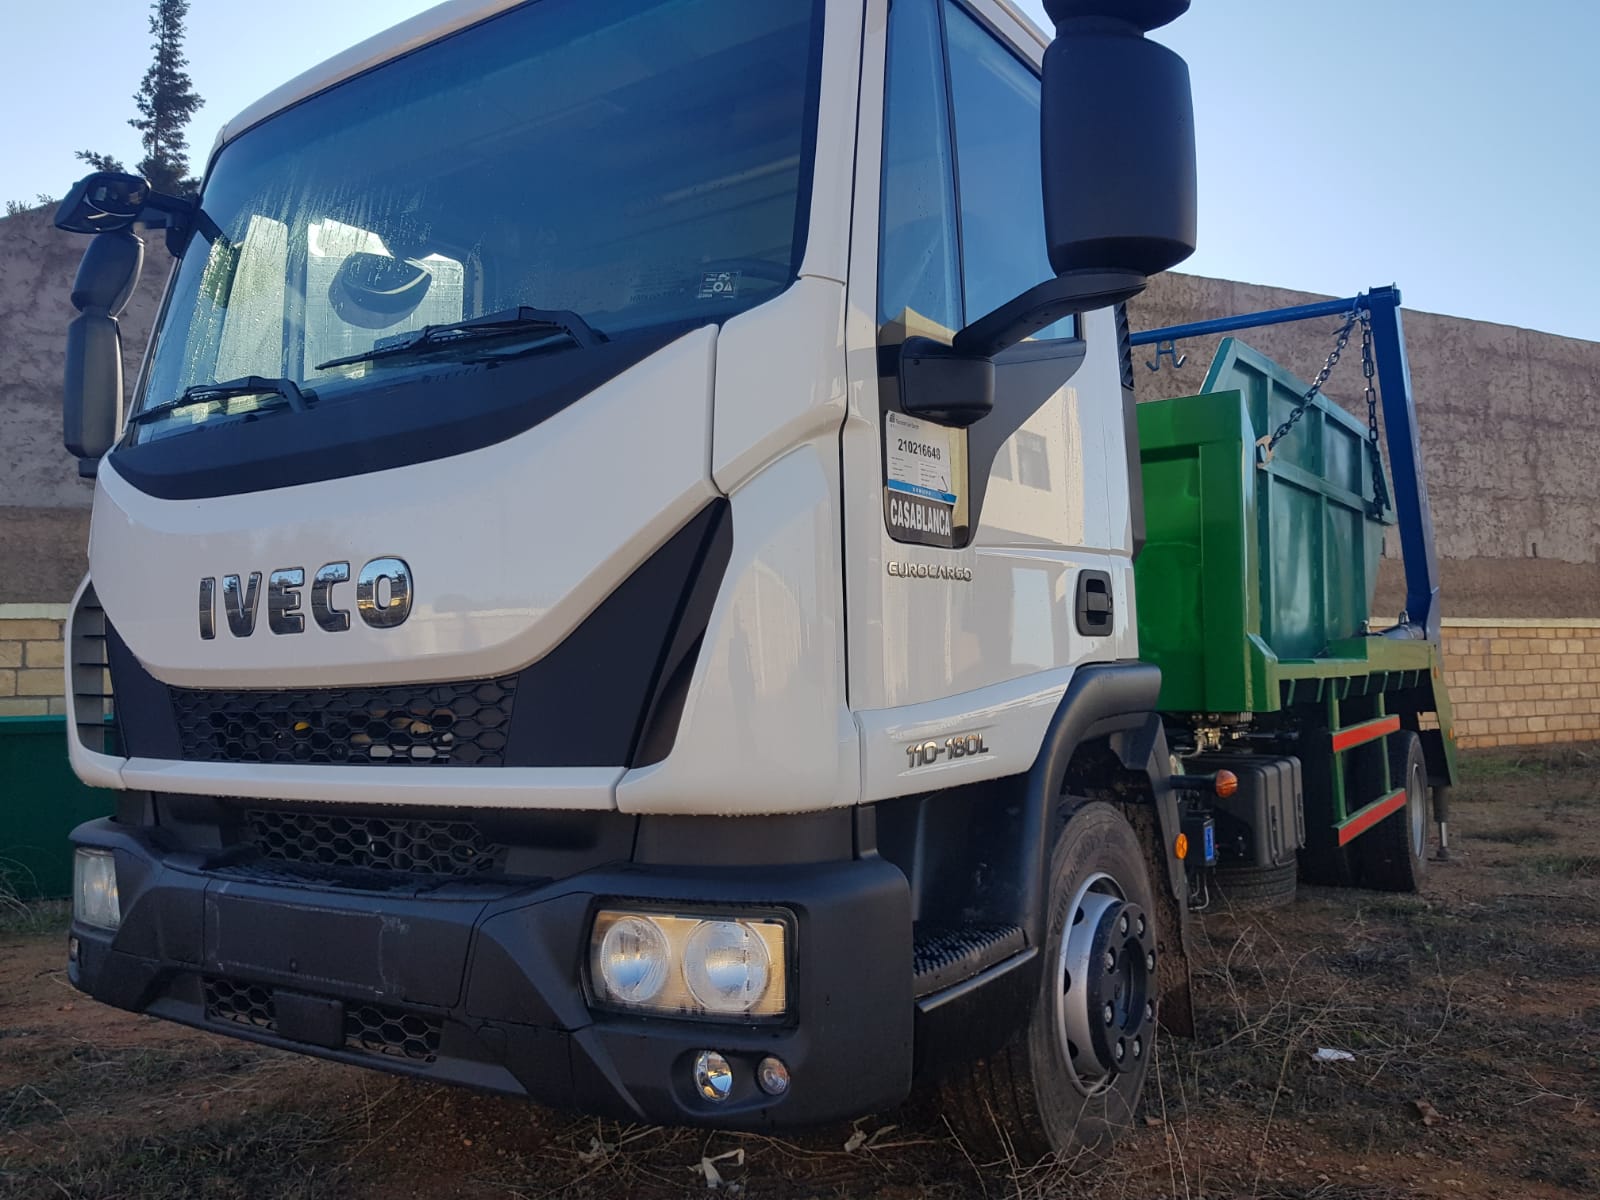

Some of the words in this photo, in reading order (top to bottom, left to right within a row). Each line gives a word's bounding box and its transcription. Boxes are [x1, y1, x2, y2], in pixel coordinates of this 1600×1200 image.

[890, 498, 951, 537] CASABLANCA
[887, 561, 973, 582] EUROCARGO
[199, 556, 414, 640] IVECO
